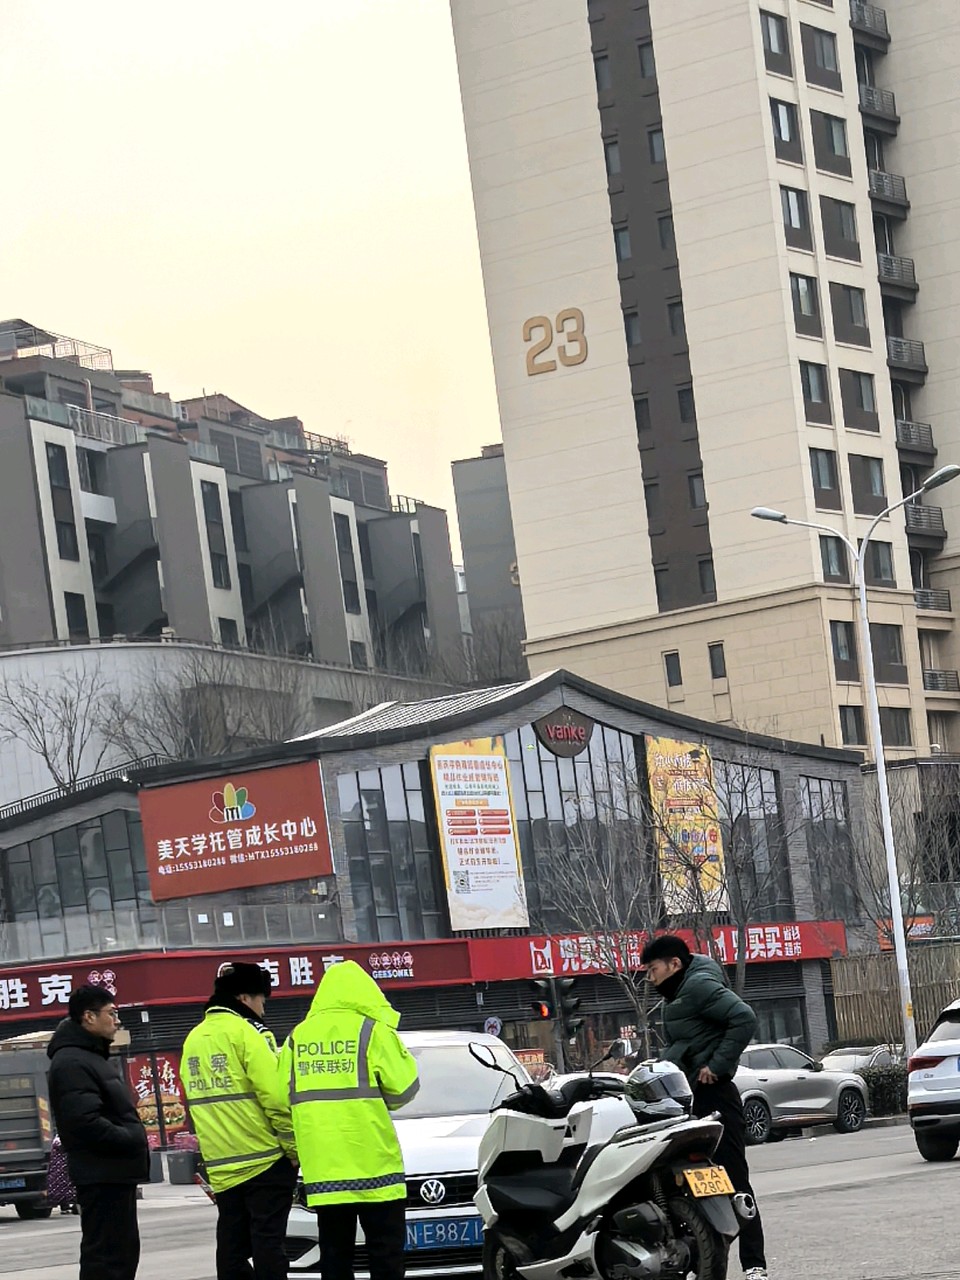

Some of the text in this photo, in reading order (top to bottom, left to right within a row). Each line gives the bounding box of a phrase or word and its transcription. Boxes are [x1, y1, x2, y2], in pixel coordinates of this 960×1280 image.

[523, 307, 588, 376] 23
[157, 816, 317, 861] 美天学托管成长中心
[297, 1040, 356, 1057] POLICE
[189, 1076, 232, 1092] POLICE
